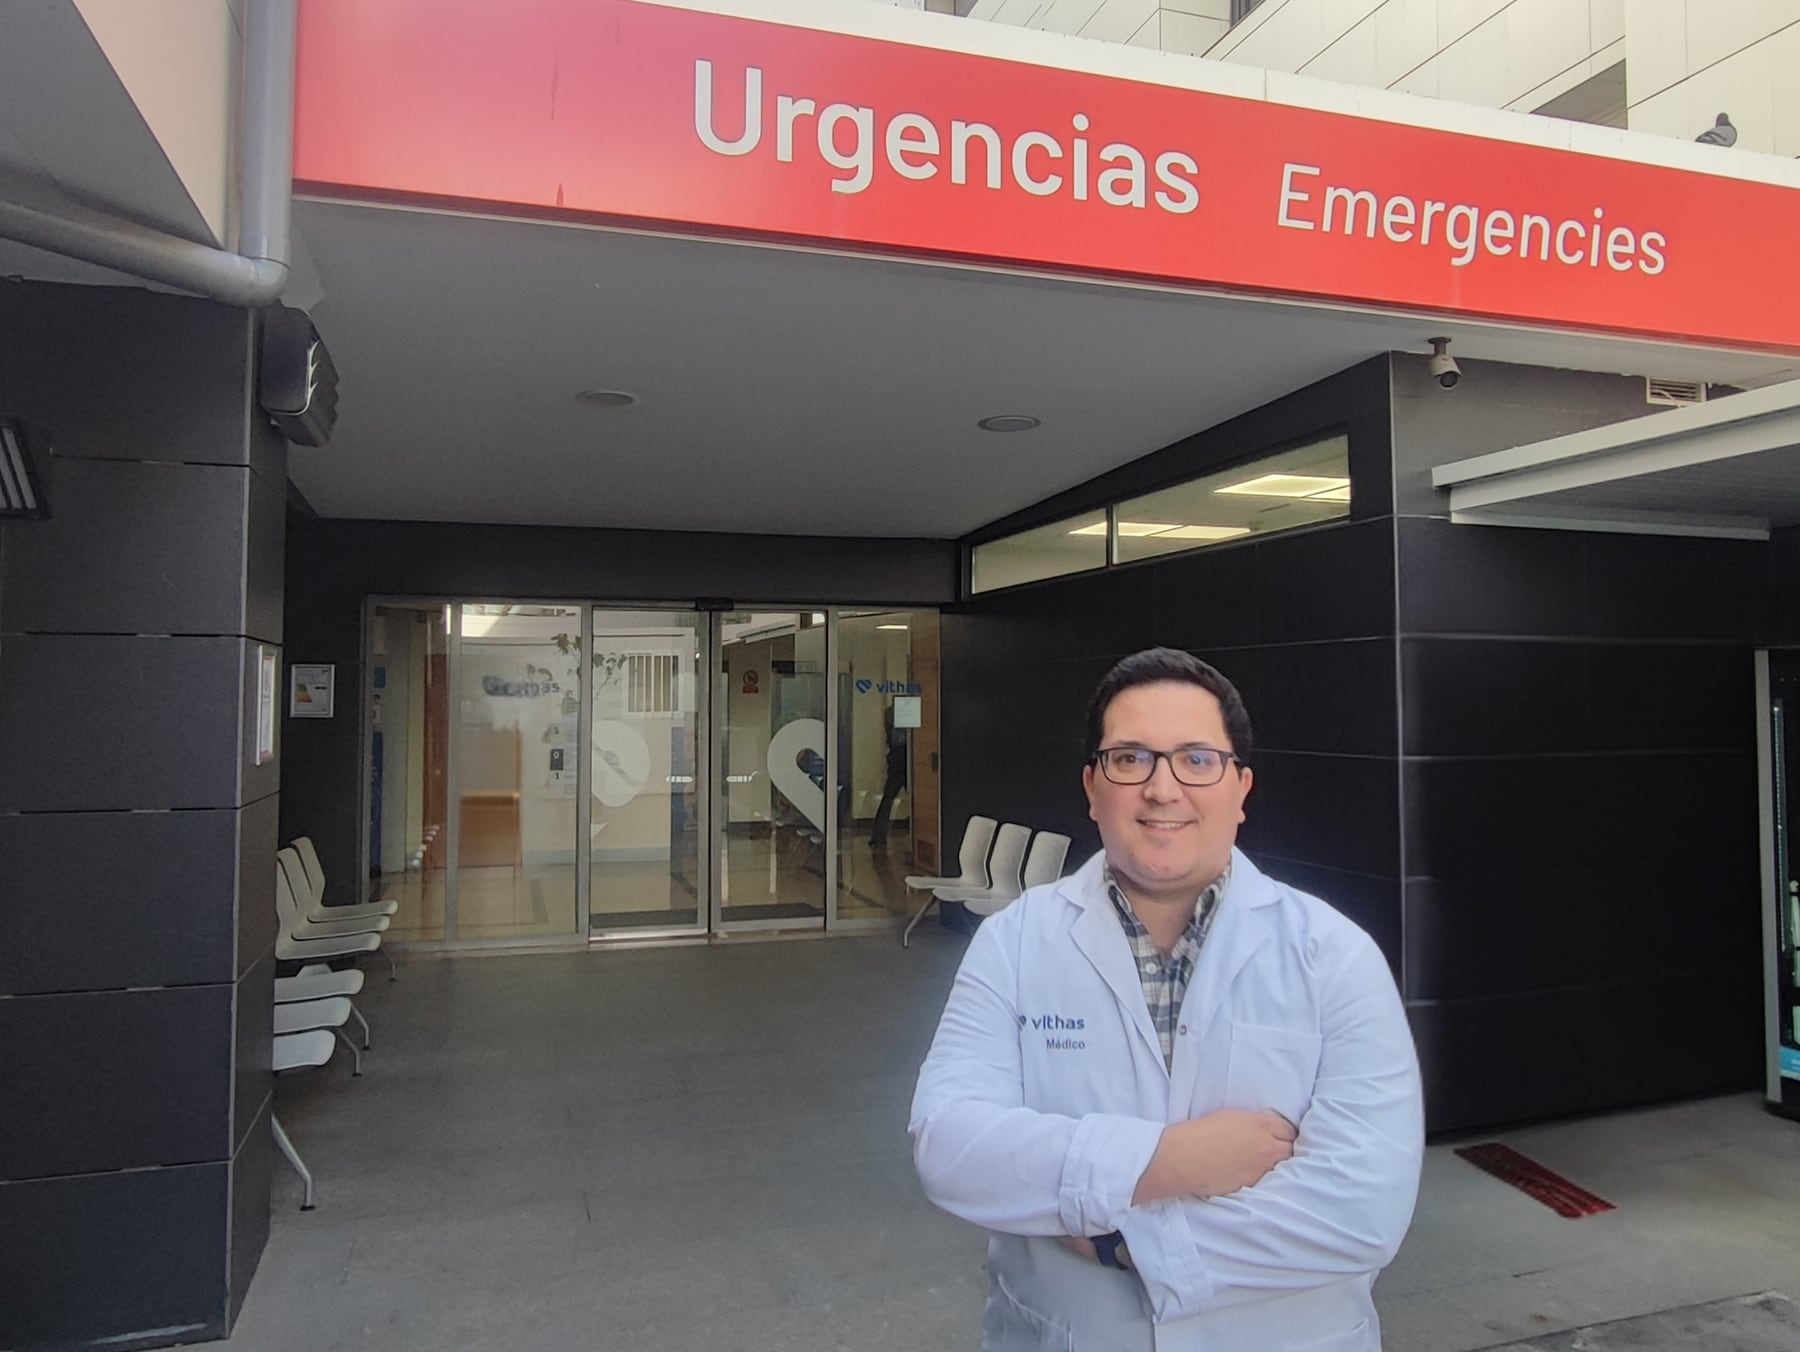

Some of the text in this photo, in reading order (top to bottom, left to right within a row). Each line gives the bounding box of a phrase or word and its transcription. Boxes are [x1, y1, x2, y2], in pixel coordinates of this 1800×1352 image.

[694, 59, 1667, 275] Urgencias Emergencies
[1031, 1014, 1085, 1030] vithas
[1046, 1038, 1086, 1050] Médico
